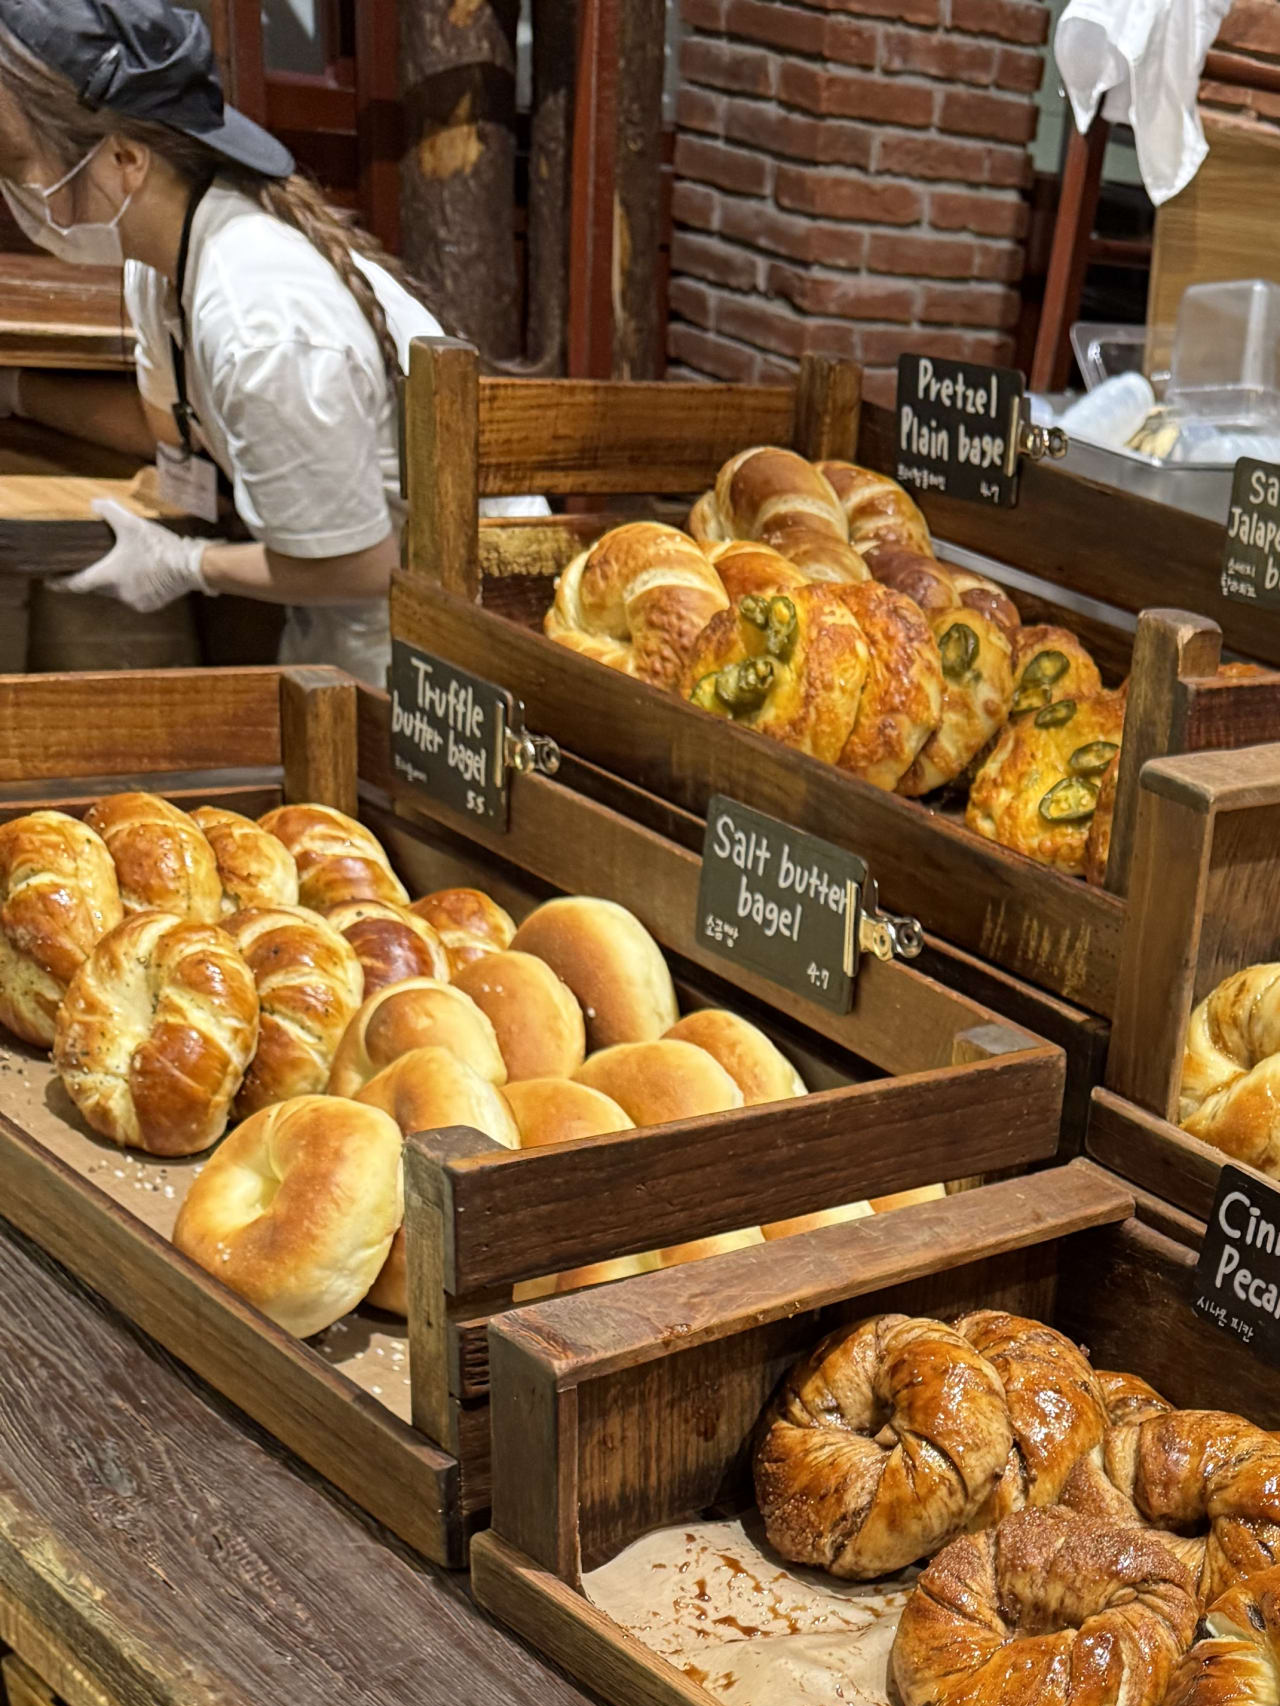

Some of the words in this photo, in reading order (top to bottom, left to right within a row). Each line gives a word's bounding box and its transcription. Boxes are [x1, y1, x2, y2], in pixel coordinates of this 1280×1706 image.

[917, 358, 998, 418] Pretzel
[901, 405, 948, 462] Plain
[958, 424, 1004, 468] bage
[411, 657, 484, 738] Truffle
[391, 690, 443, 753] butter
[448, 729, 487, 788] bagel
[713, 814, 771, 877] Salt
[778, 844, 849, 915] butter
[705, 913, 739, 948] 소금빵
[737, 874, 802, 942] bagel
[806, 961, 830, 990] 4.7
[1196, 1295, 1228, 1327] 시나몬
[1230, 1317, 1255, 1344] 피칸
